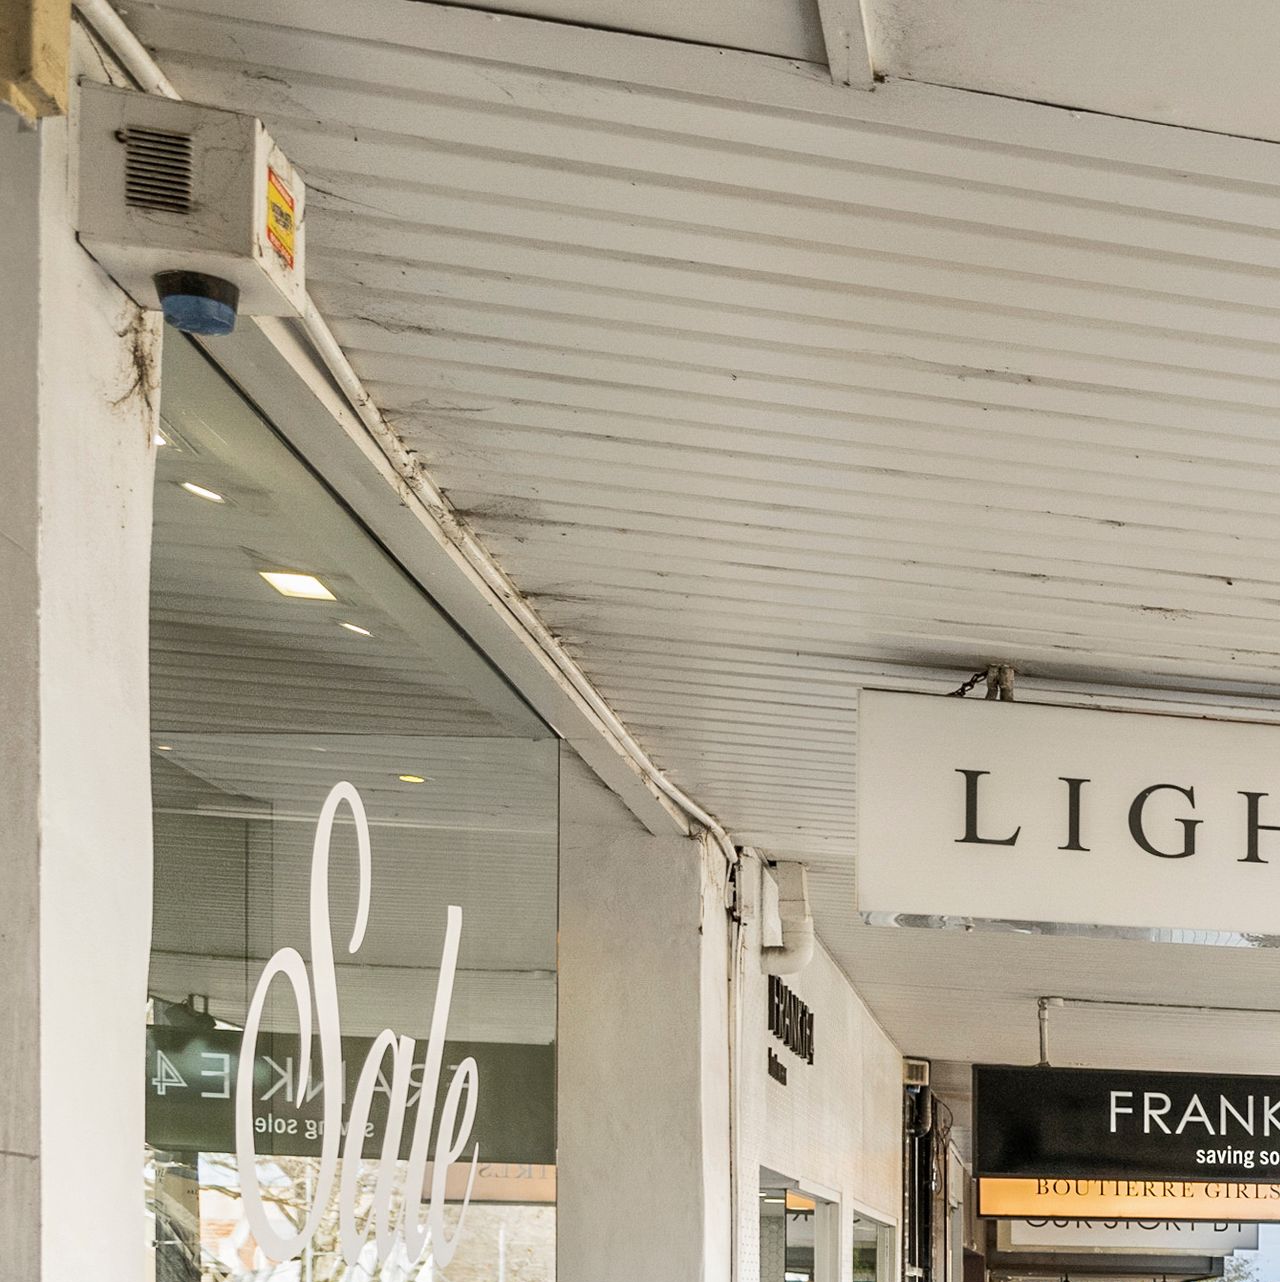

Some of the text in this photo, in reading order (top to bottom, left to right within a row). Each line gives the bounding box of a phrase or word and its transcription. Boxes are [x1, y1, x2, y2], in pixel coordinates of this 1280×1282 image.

[236, 781, 479, 1267] Sale
[1196, 1145, 1254, 1168] saving
[1035, 1178, 1280, 1200] BOUTIERRE GIRLS
